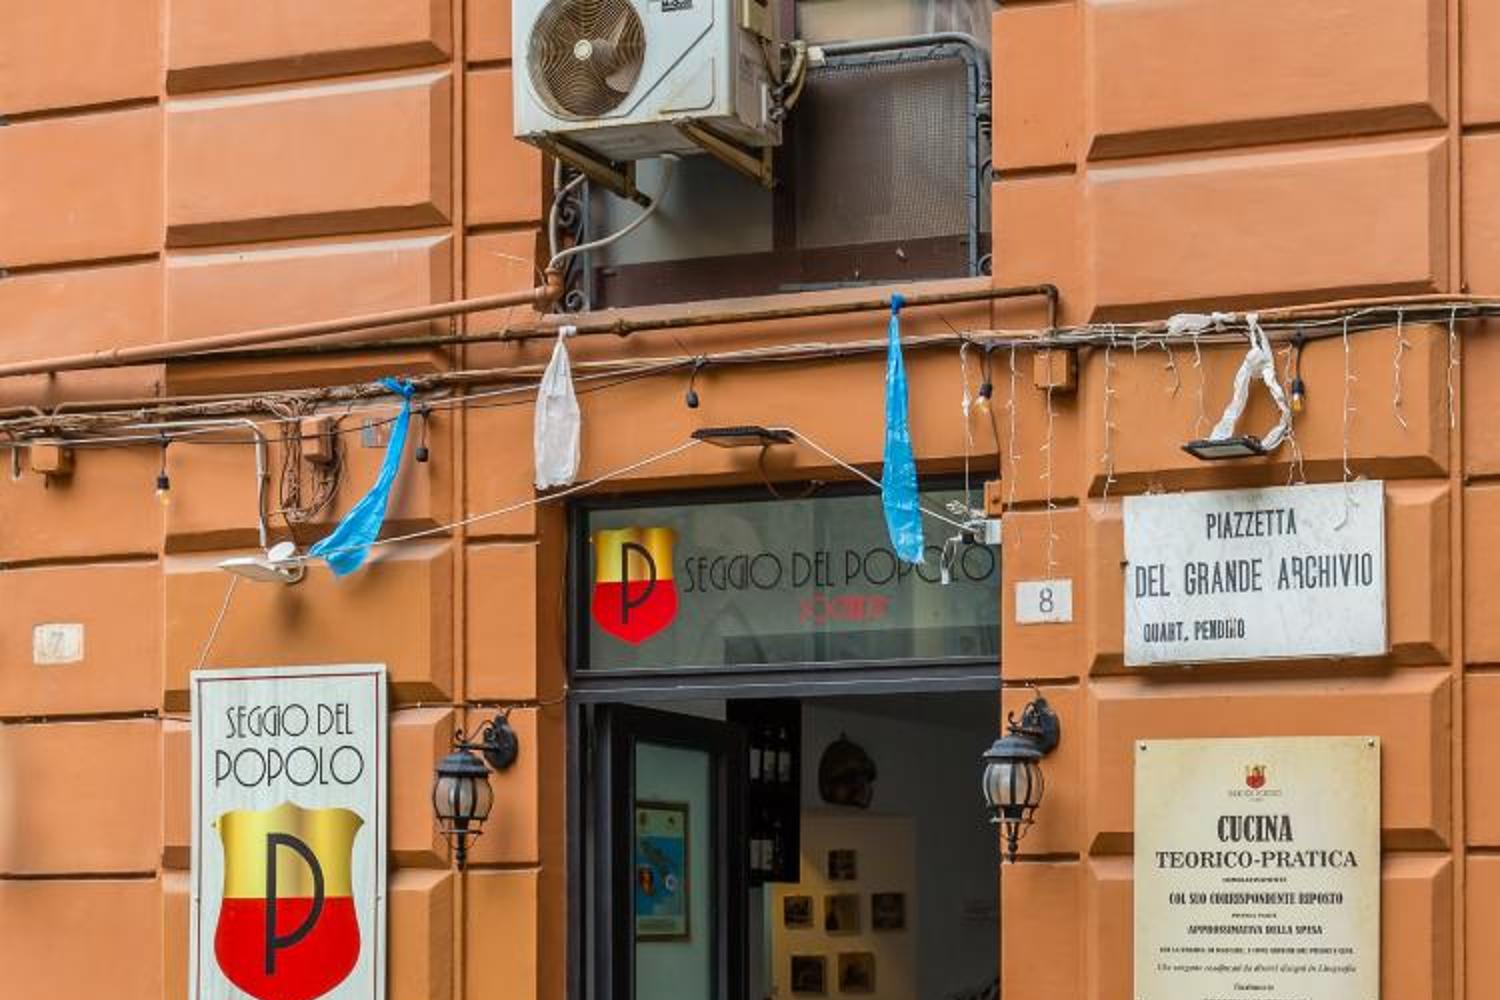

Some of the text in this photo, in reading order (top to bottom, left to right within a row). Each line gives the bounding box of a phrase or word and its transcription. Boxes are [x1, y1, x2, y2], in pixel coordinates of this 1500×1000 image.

[1206, 508, 1297, 540] PIAZZETTA
[683, 552, 783, 593] SEGGIO
[791, 550, 835, 588] DEL
[1135, 553, 1374, 598] DEL GRANDE ARCHIVIO
[1039, 586, 1053, 613] 8
[1143, 617, 1246, 643] QUART. PENDINO
[225, 703, 354, 739] SEGGIO DEL
[214, 744, 365, 788] POPOLO
[1216, 814, 1293, 842] CUCINA
[1156, 850, 1358, 868] TEORICO-PRATICA
[265, 832, 325, 976] P
